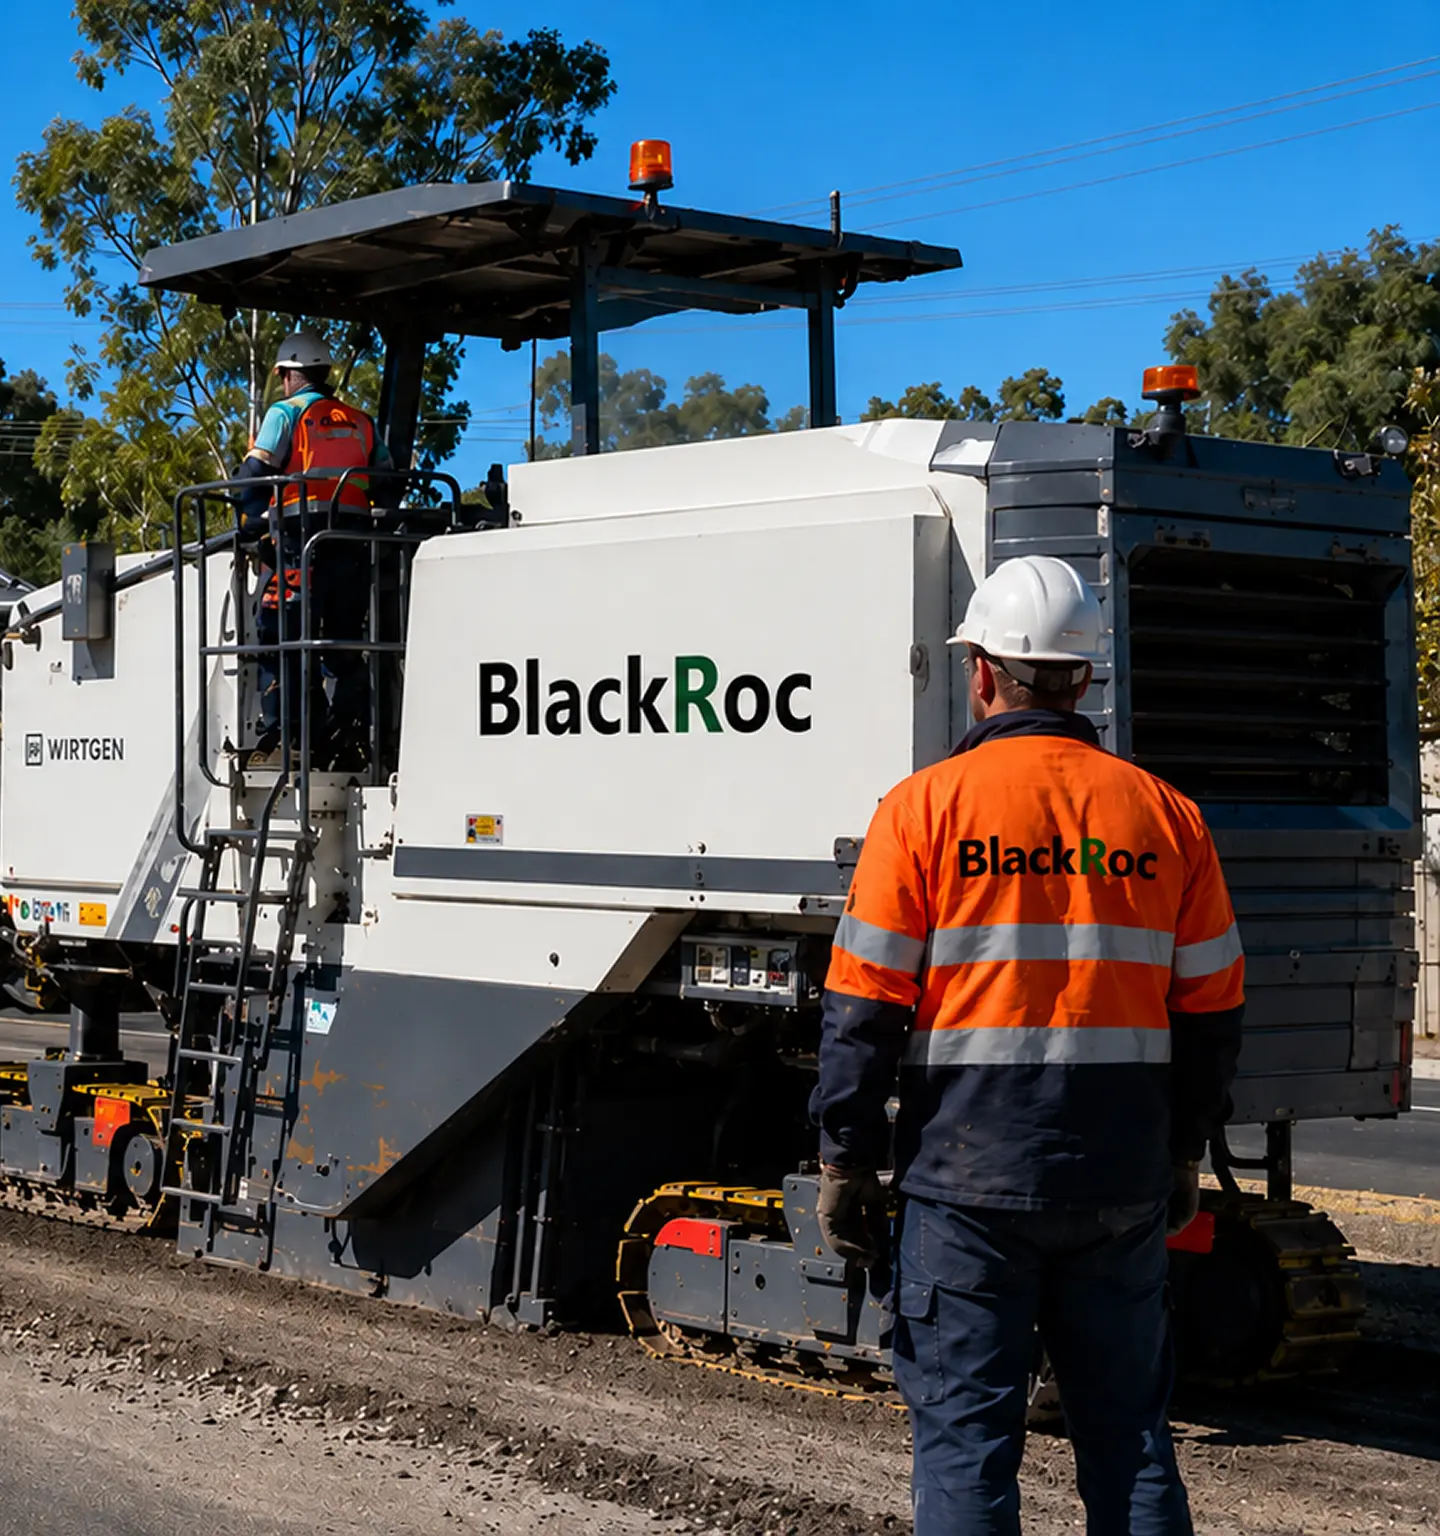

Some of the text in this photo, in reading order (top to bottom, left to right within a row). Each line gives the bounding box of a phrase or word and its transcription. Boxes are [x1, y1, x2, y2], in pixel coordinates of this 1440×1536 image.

[479, 655, 811, 736] BlackRoc
[48, 738, 124, 760] WIRTGEN
[959, 836, 1158, 880] BlackRoc
